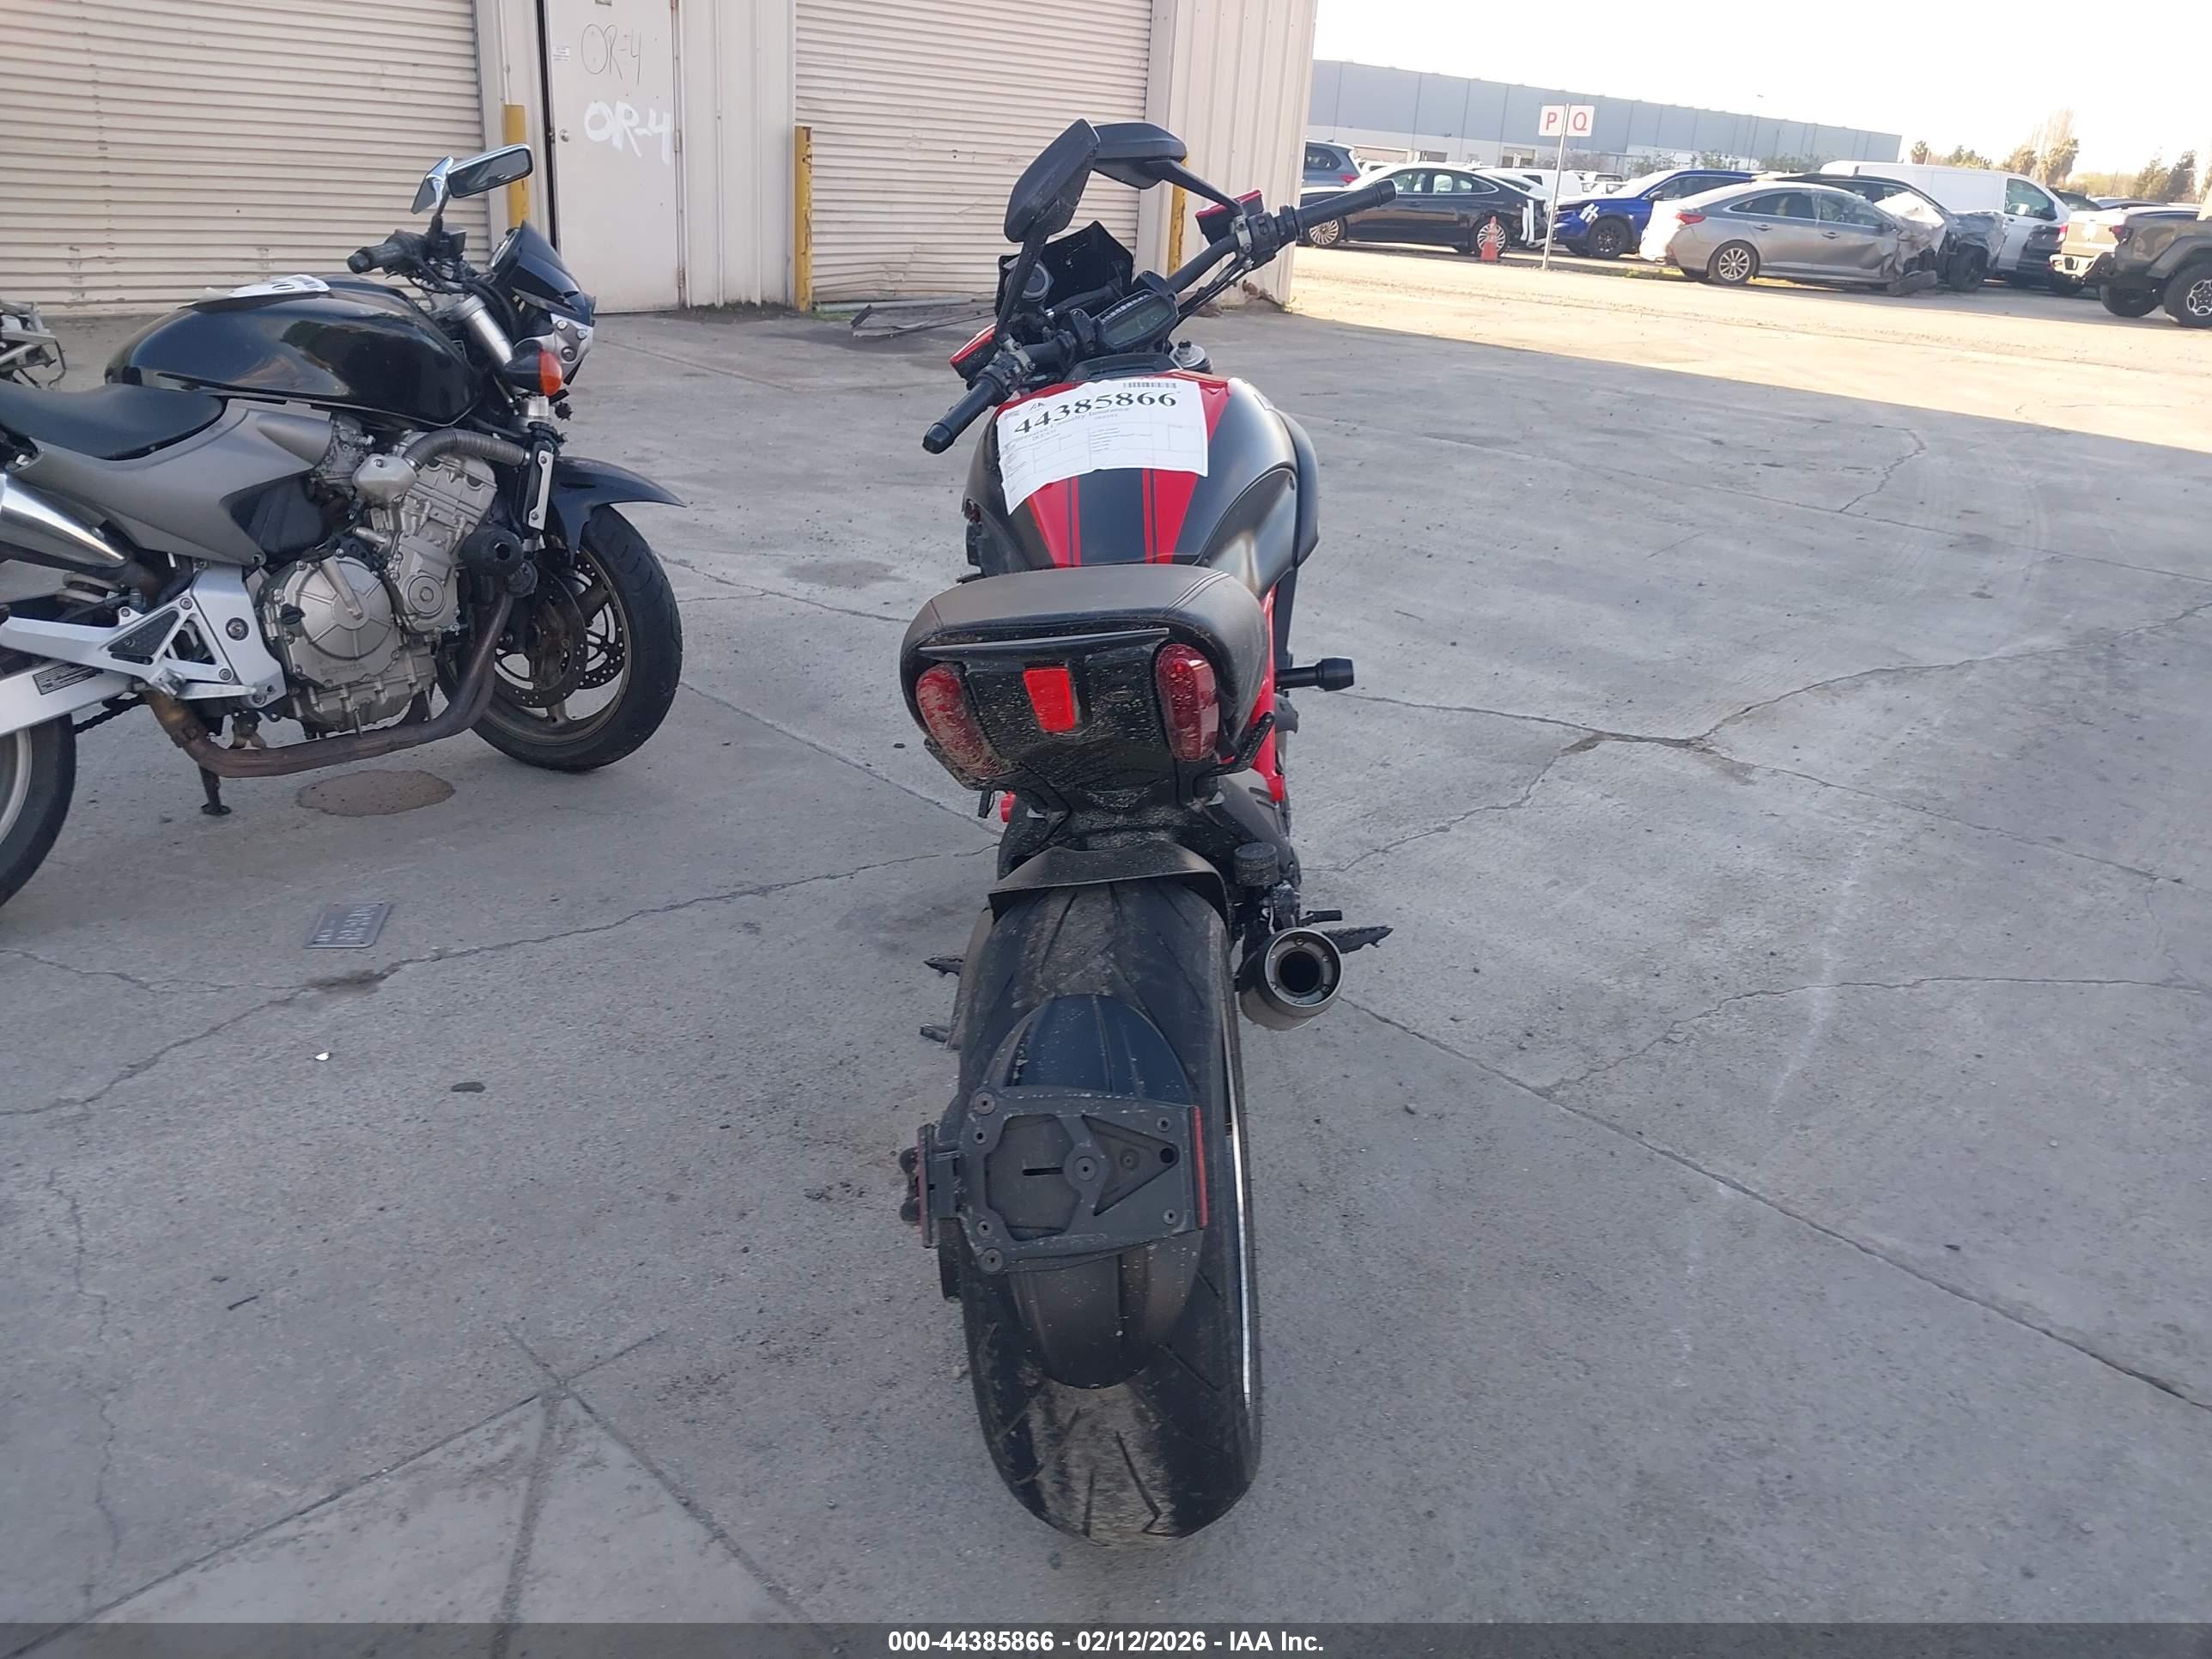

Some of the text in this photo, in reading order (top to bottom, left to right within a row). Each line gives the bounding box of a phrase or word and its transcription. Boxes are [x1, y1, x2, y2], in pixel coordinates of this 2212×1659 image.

[581, 24, 642, 84] OR-4
[584, 100, 672, 165] OR-4
[1546, 112, 1558, 131] P
[1573, 112, 1587, 131] Q
[1014, 392, 1176, 433] 44385866
